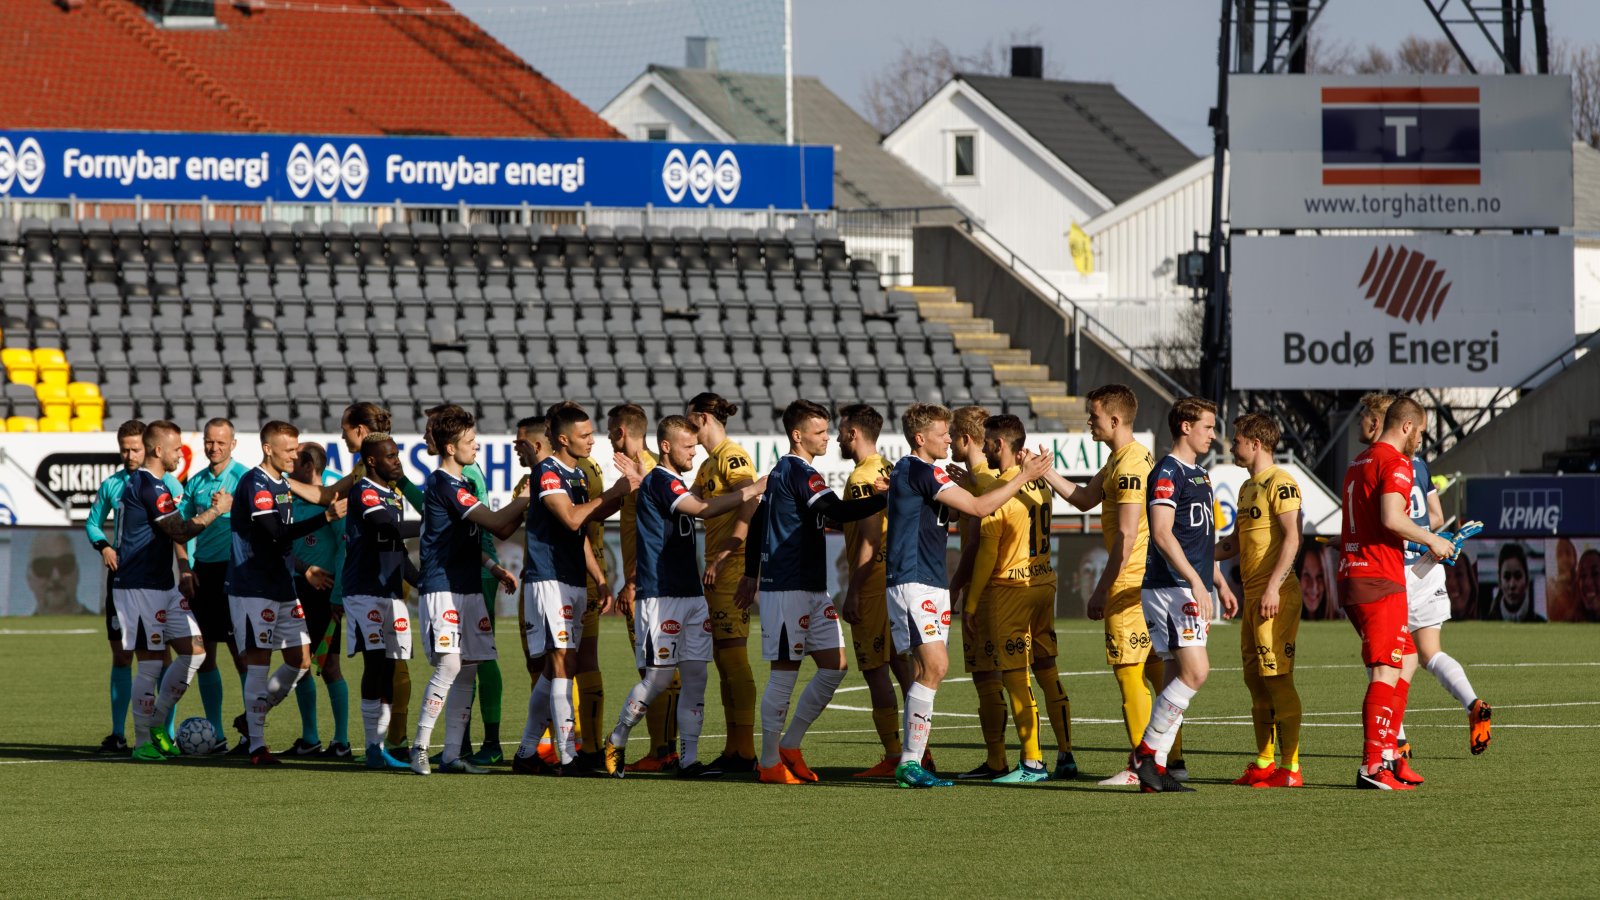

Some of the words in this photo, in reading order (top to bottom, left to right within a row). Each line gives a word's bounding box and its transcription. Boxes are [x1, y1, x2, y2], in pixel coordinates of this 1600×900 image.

[1385, 116, 1417, 156] T
[63, 148, 181, 186] Fornybar
[185, 151, 270, 188] energi
[386, 154, 500, 191] Fornybar
[504, 157, 585, 193] energi
[1304, 193, 1502, 218] www.torghatten.no
[1283, 330, 1375, 368] Bodø
[1388, 330, 1499, 373] Energi
[48, 463, 125, 492] SIKRIN
[1119, 476, 1141, 490] an
[1028, 502, 1051, 557] 19
[1499, 505, 1560, 530] KPMG
[671, 642, 677, 659] 7
